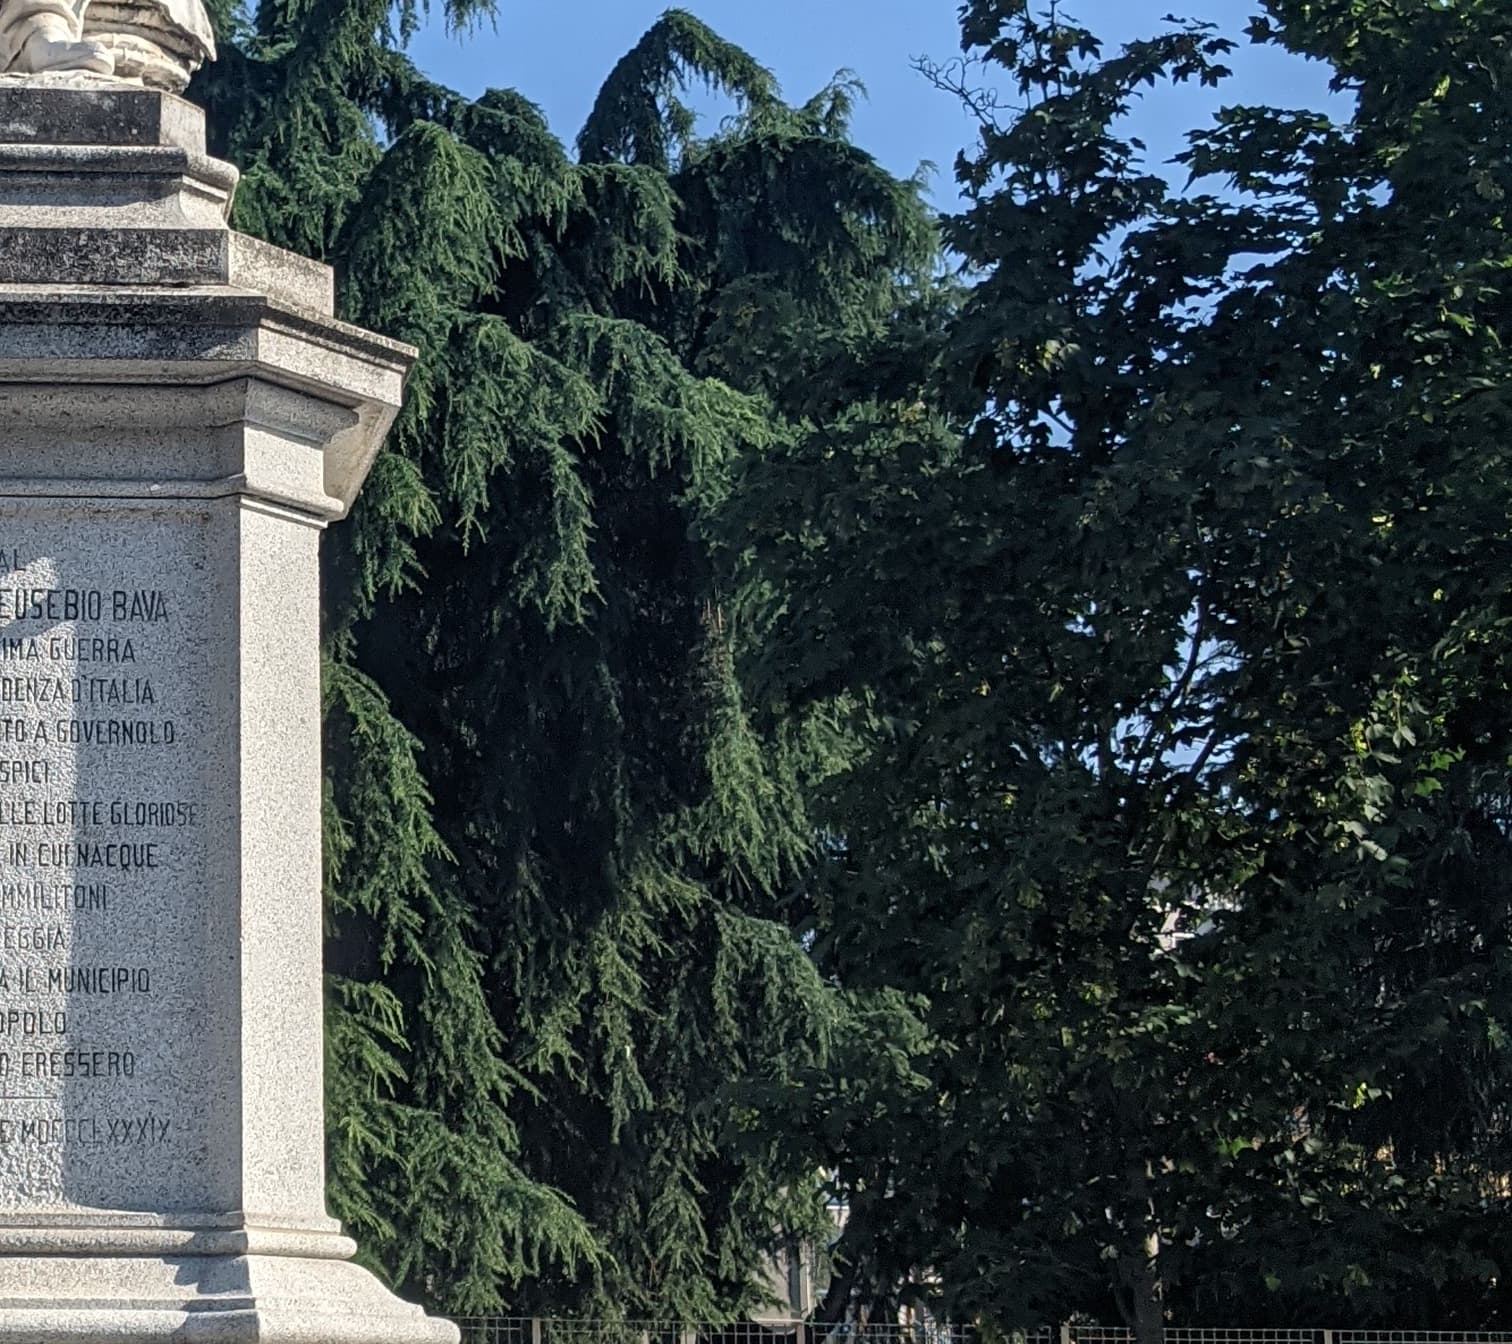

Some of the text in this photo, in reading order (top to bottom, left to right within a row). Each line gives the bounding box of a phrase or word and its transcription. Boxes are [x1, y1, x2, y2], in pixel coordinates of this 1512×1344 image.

[112, 590, 169, 623] BAVA
[50, 638, 137, 663] GUERRA
[34, 720, 48, 744] A
[56, 719, 176, 746] GOVERNOLO
[10, 843, 29, 867] IN
[38, 843, 70, 868] CUI
[76, 843, 159, 871] NACQUE
[19, 967, 38, 993] IL
[48, 967, 151, 994] MUNICIPIO
[21, 1052, 136, 1078] ERESSERO
